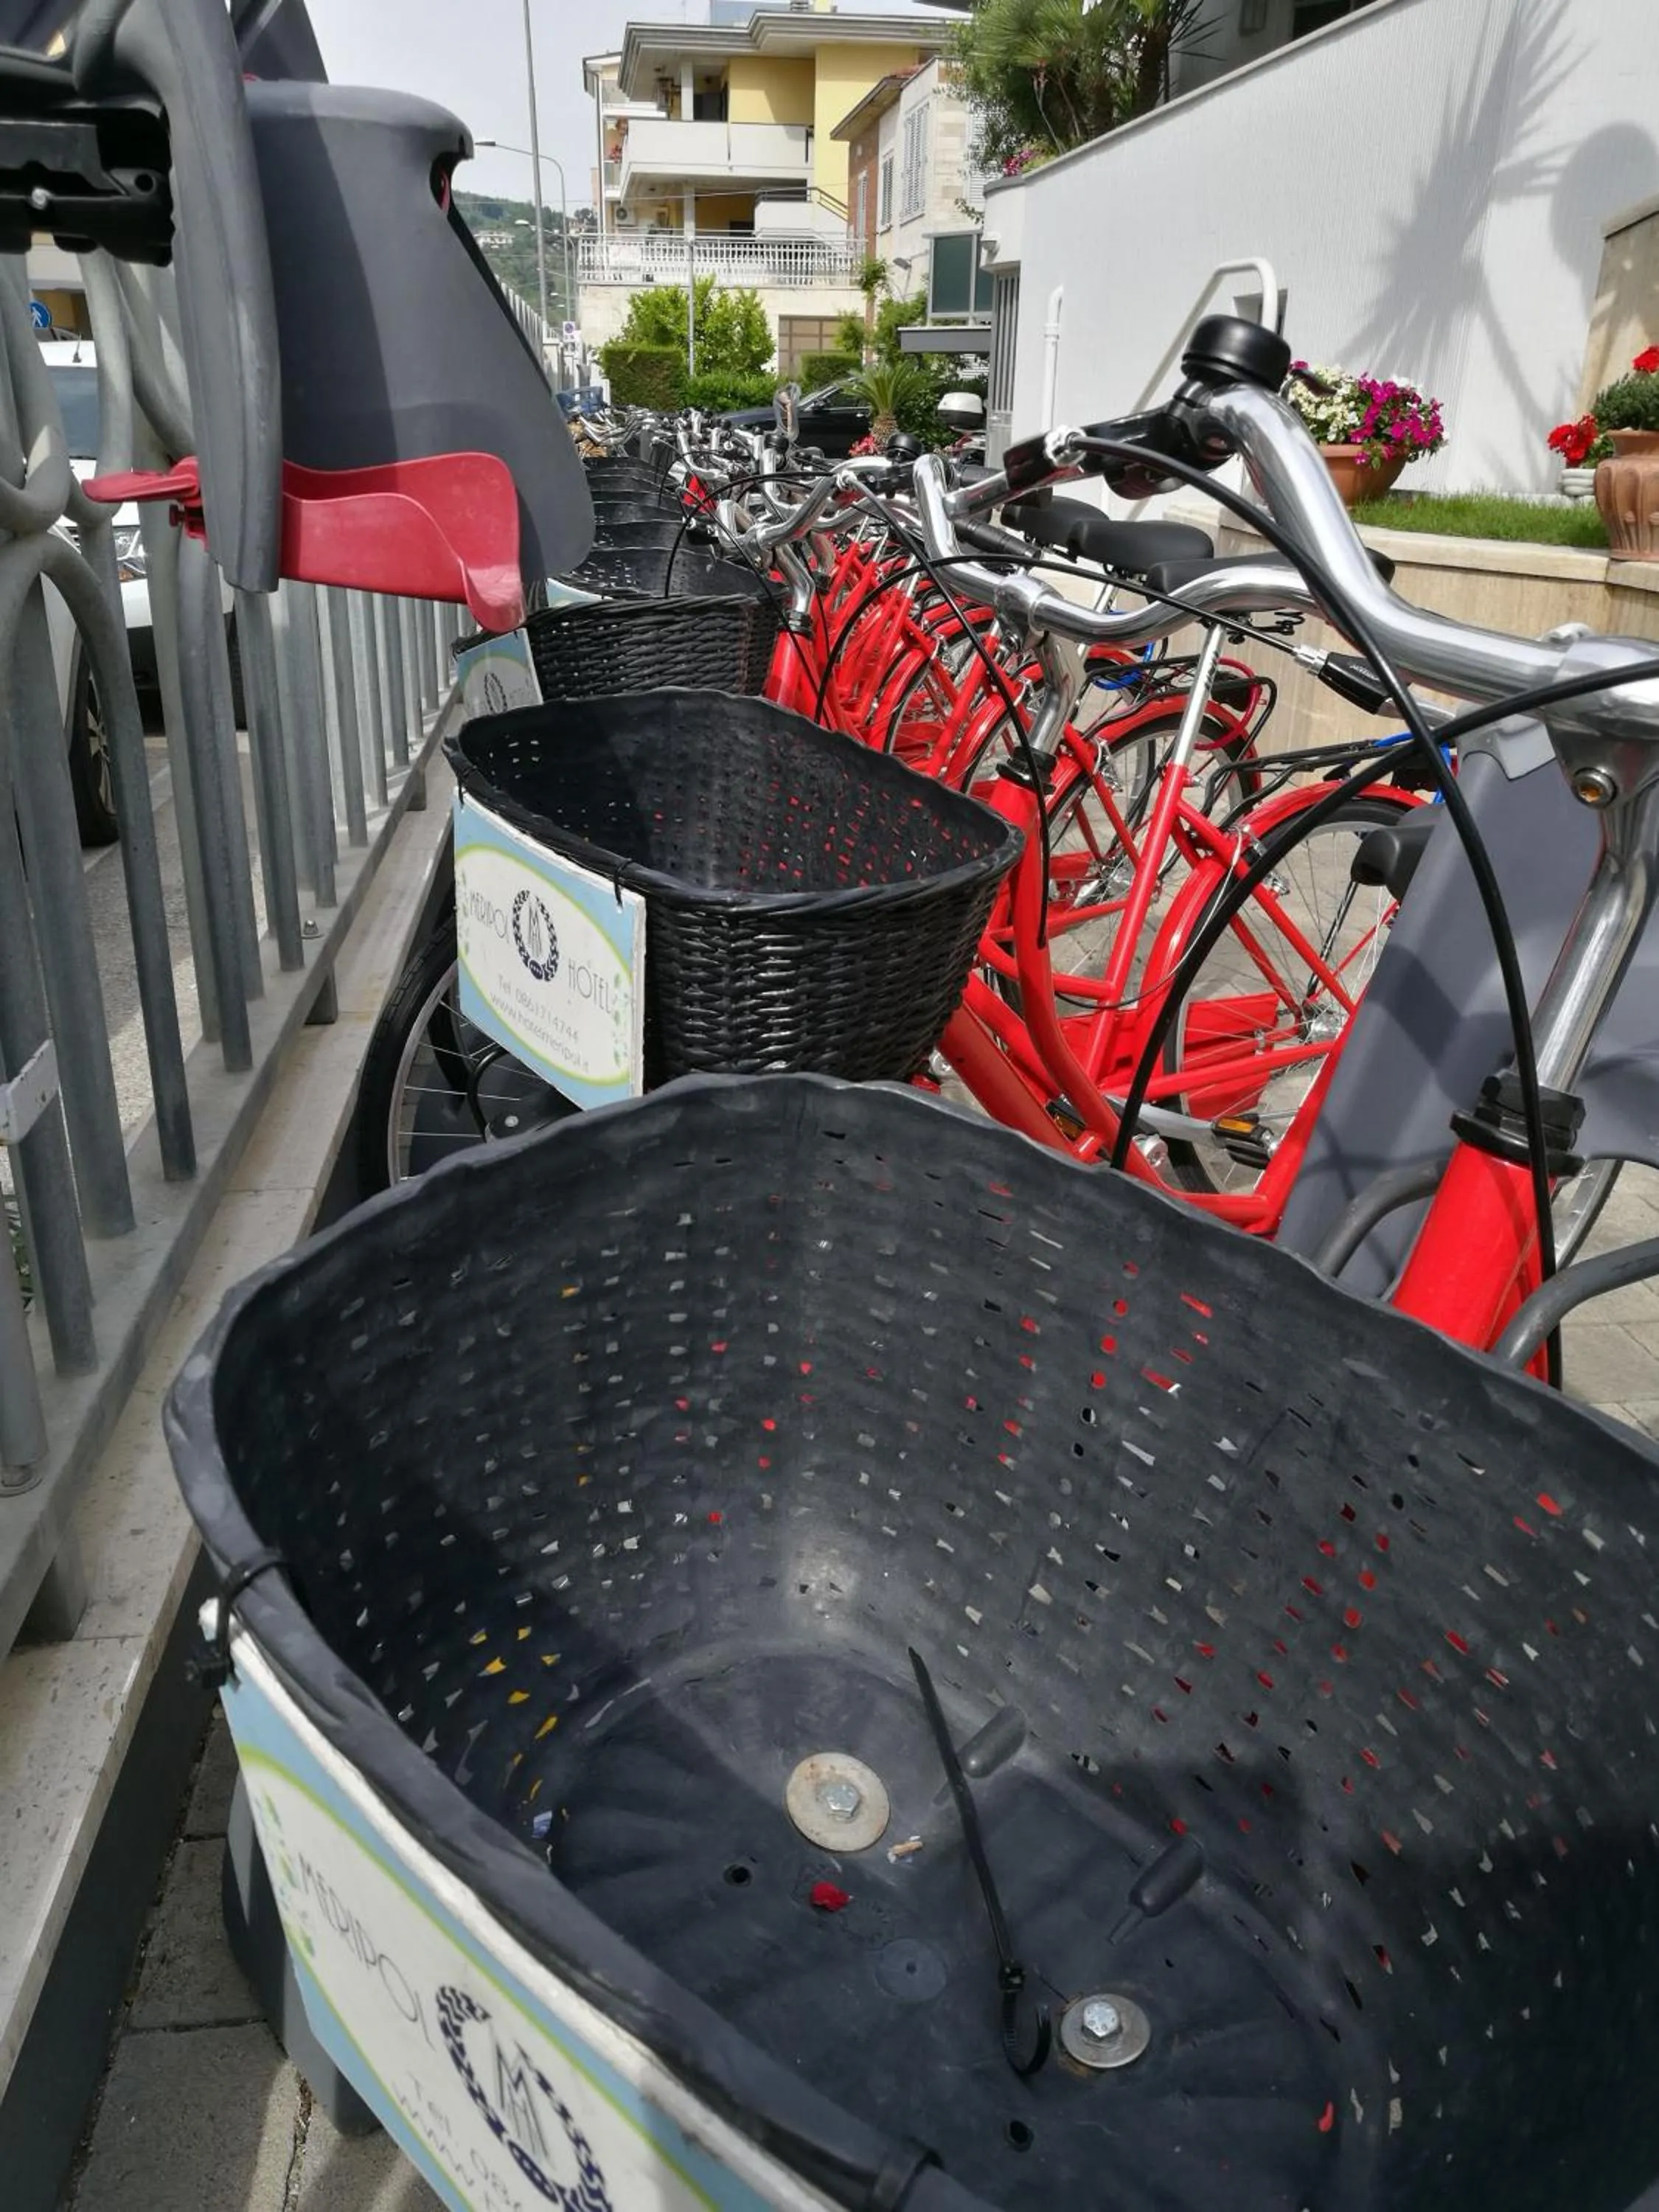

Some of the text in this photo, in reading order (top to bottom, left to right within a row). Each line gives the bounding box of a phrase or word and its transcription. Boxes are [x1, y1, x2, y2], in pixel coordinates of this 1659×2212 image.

[470, 891, 509, 944] MERIPOL
[568, 958, 611, 1014] HOTEL
[298, 1851, 437, 2053] MERIPOL
